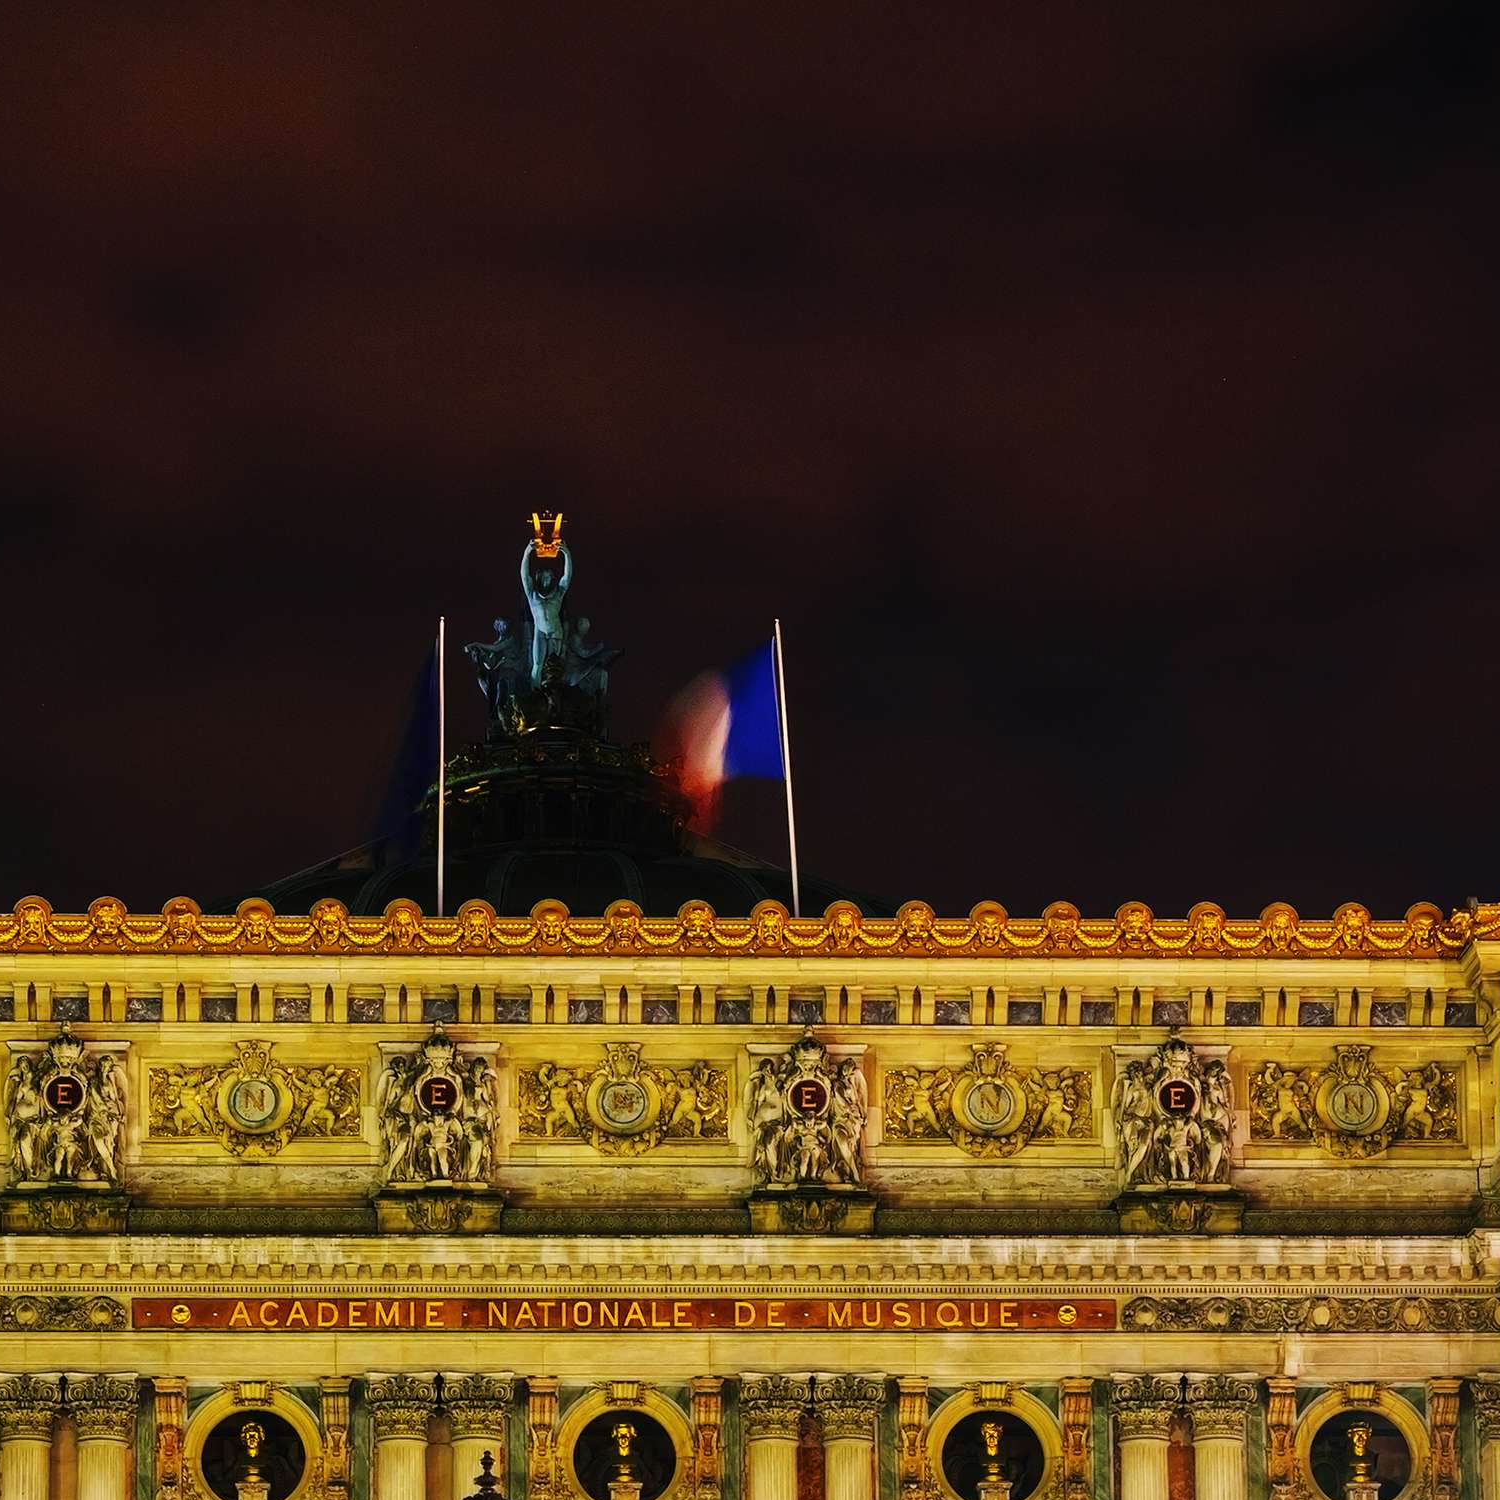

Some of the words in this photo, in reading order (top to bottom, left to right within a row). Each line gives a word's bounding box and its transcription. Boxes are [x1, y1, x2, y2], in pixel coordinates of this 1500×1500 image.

[57, 1084, 72, 1104] E
[244, 1088, 265, 1112] N
[431, 1084, 446, 1105] E
[801, 1087, 817, 1107] E
[980, 1091, 1001, 1114] N
[1170, 1088, 1186, 1108] E
[1343, 1092, 1364, 1115] N
[228, 1301, 445, 1328] ACADEMIE
[487, 1301, 694, 1327] NATIONALE
[734, 1301, 786, 1327] DE
[827, 1301, 1019, 1328] MUSIQUE
